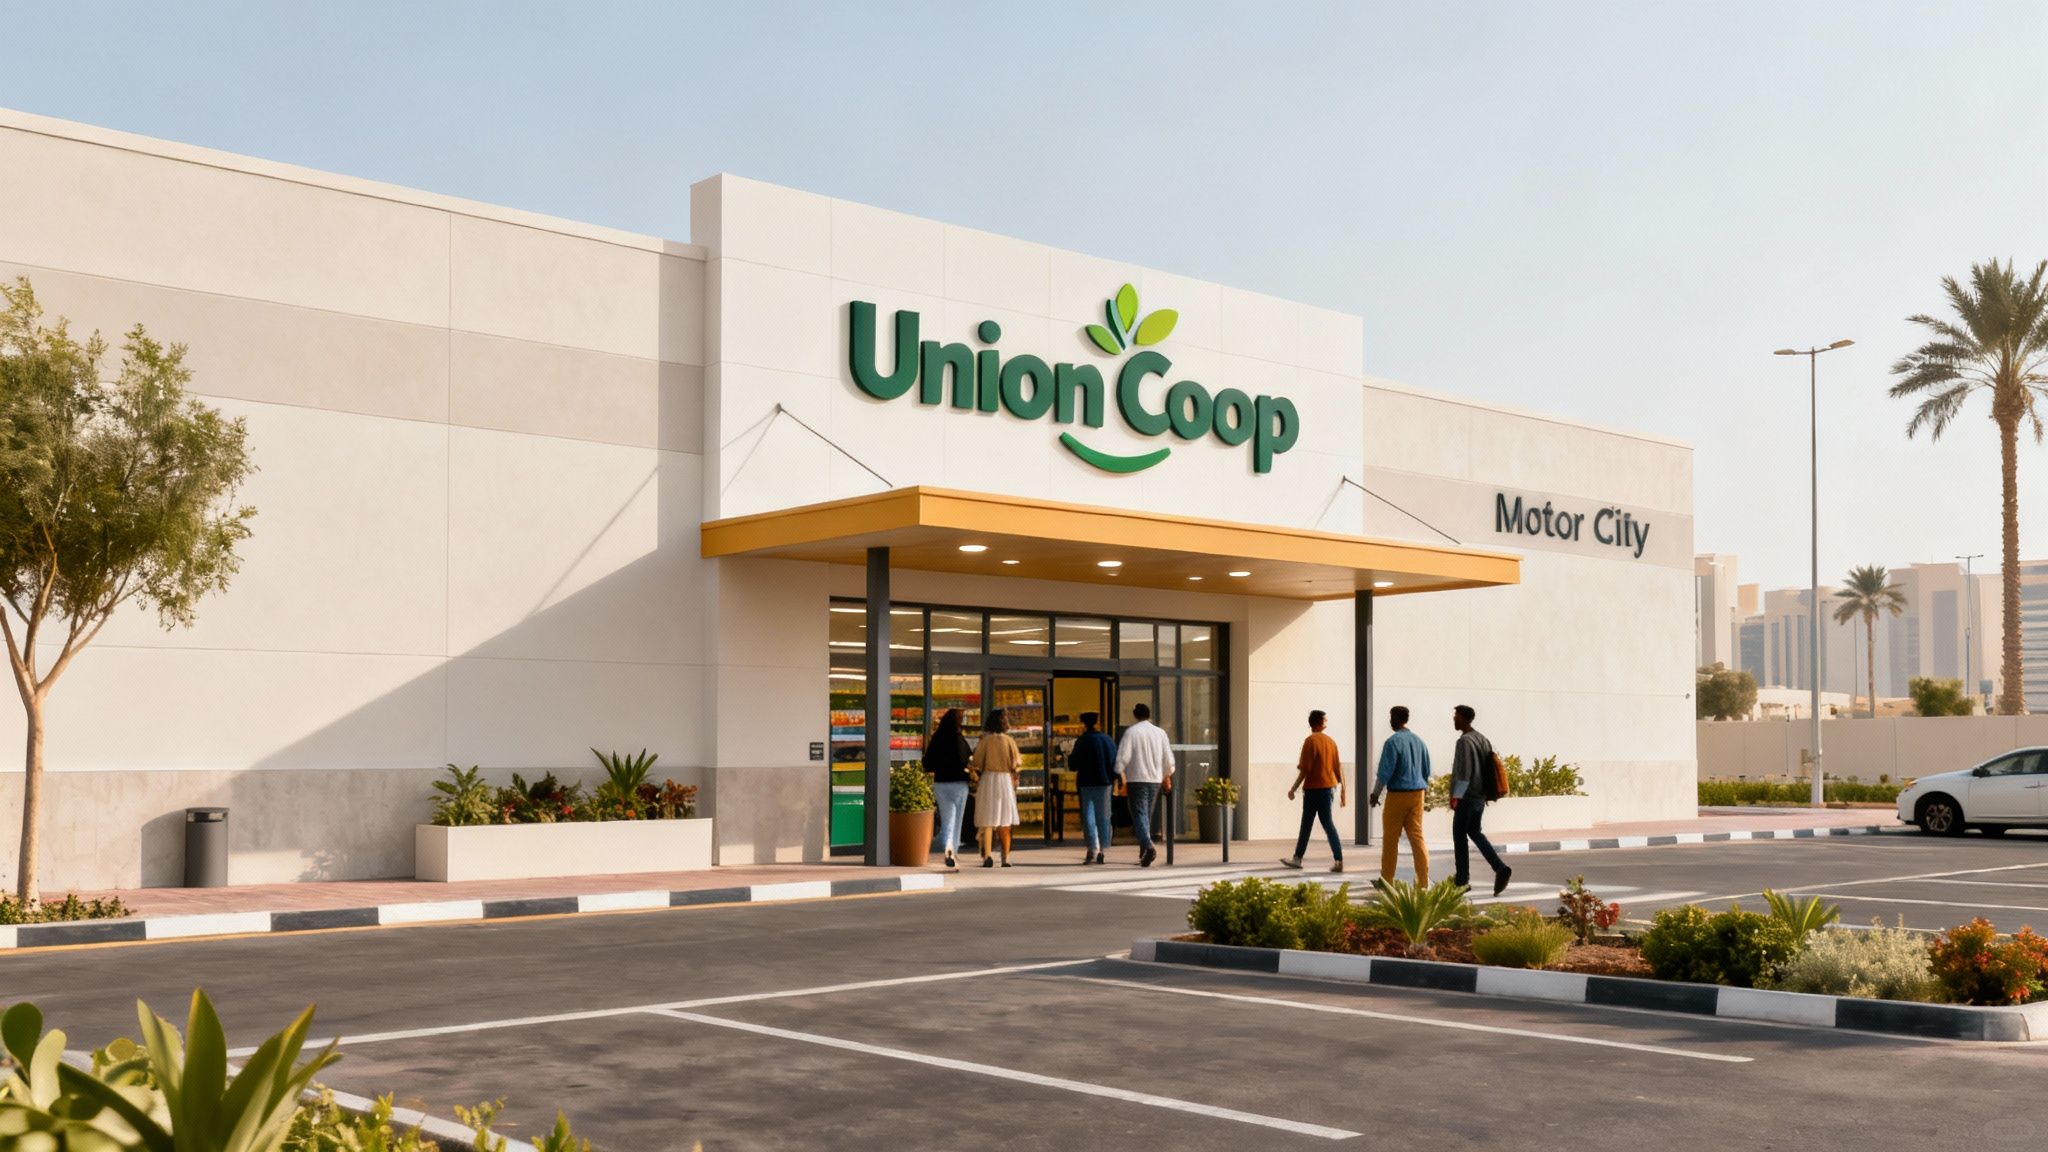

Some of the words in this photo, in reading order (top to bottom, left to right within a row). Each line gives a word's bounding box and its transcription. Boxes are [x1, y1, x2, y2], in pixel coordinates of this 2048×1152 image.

[849, 300, 1104, 428] Union
[1116, 351, 1300, 473] Coop
[1496, 493, 1584, 541] Motor
[1594, 508, 1650, 559] City
